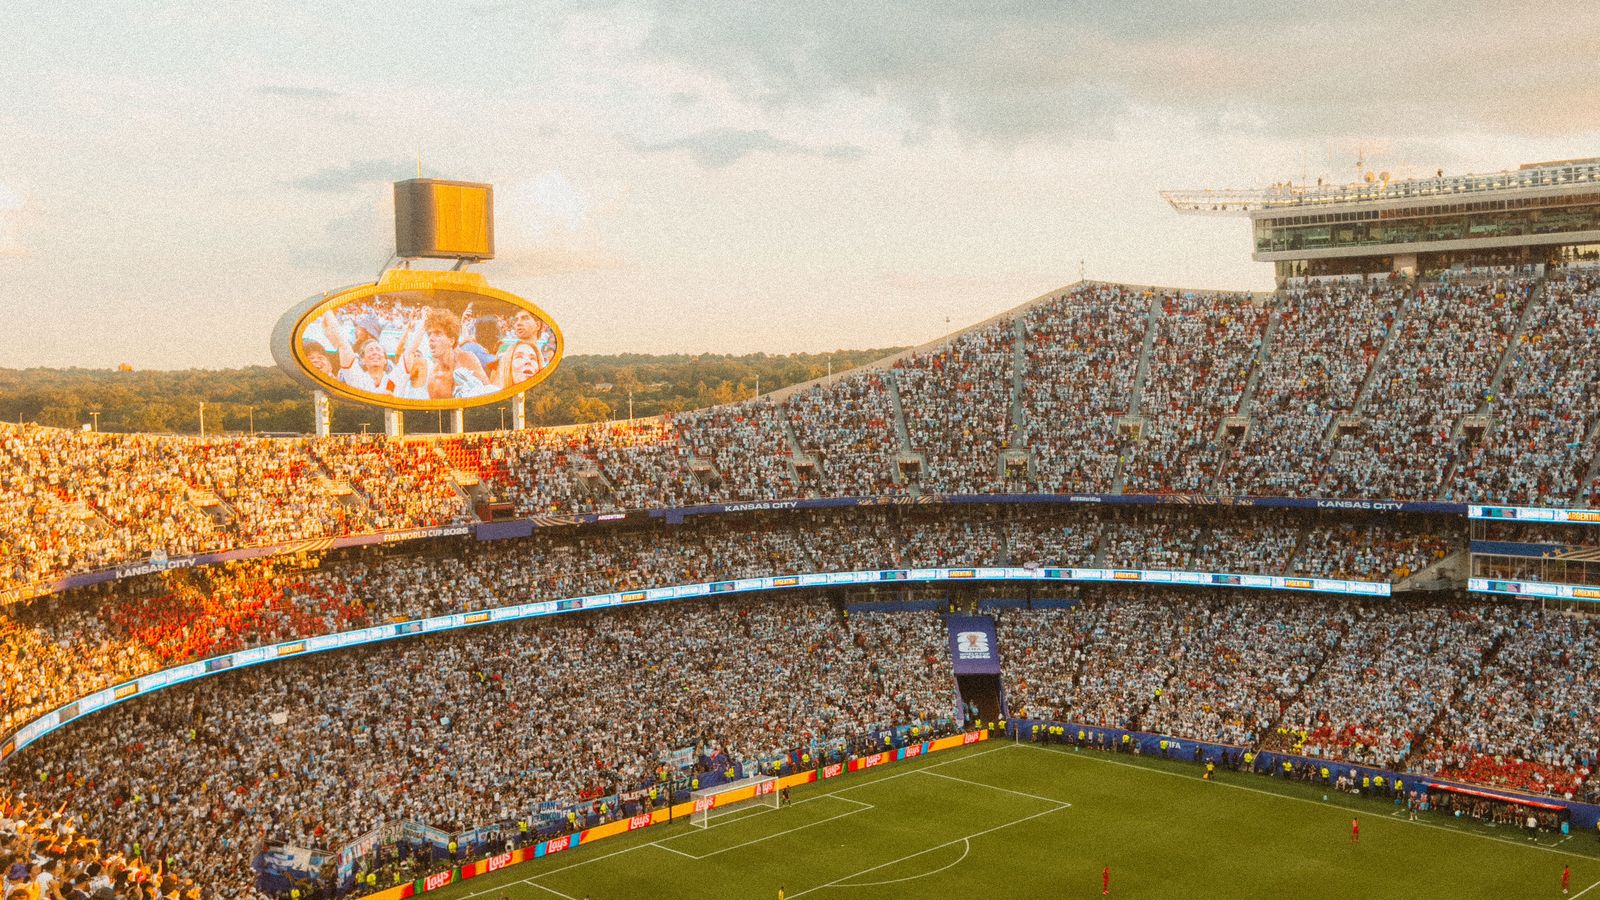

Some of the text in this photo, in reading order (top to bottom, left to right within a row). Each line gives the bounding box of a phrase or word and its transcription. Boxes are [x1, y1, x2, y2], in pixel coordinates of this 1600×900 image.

[725, 501, 797, 512] KANSAS CITY
[1317, 500, 1403, 510] KANSAS CITY
[384, 527, 469, 541] FIFA WORLD CUP 2026
[116, 557, 196, 579] KANSAS CITY
[879, 730, 892, 739] FIFA
[1168, 740, 1181, 749] IFA
[630, 814, 651, 830] Lay's
[548, 837, 569, 853] Lay's
